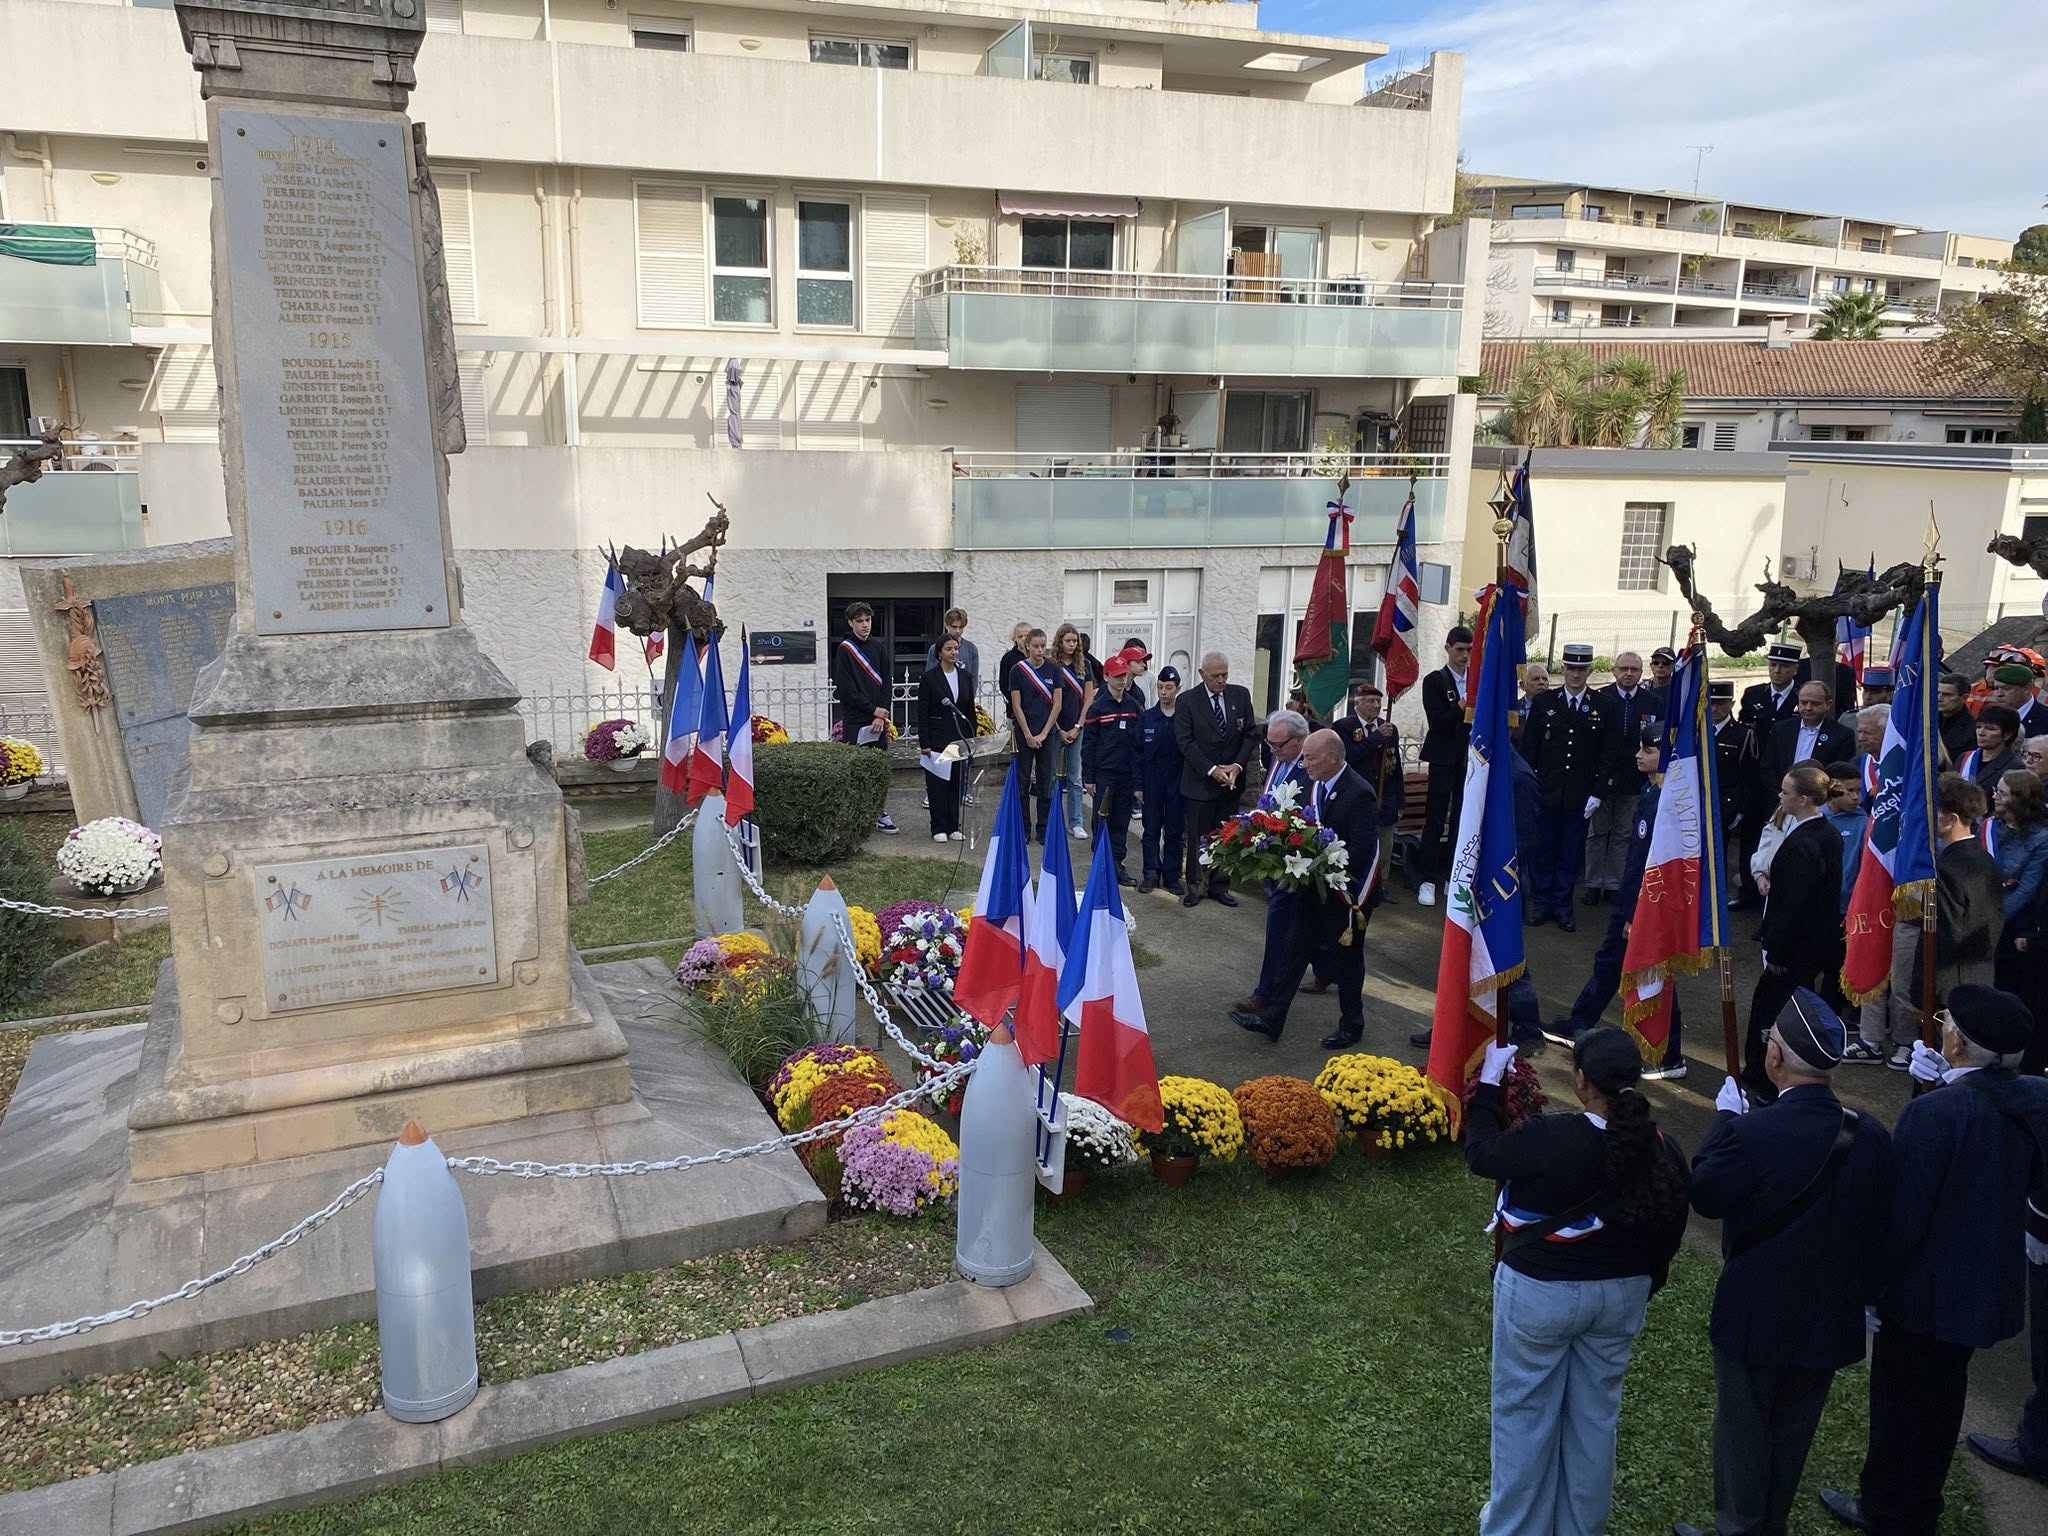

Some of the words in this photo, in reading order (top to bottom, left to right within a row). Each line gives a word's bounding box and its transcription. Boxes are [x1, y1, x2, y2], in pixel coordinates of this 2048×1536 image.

[292, 136, 336, 153] 1914
[325, 178, 354, 189] Albert
[267, 187, 316, 199] FERRIER
[319, 190, 353, 201] Octave
[263, 199, 316, 211] DAUMAS
[263, 225, 330, 238] ROUSSELET
[267, 263, 333, 275] MOURGUES
[336, 266, 364, 276] Pierre
[274, 288, 330, 300] TEIXIDOR
[333, 291, 363, 301] Ernest
[280, 301, 335, 312] CHARRAS
[339, 303, 359, 312] Jean
[278, 313, 323, 324] ALBERT
[325, 315, 364, 325] Fernand
[308, 332, 352, 349] 1915
[281, 358, 336, 368] BOURDEL
[338, 359, 364, 368] Louis
[333, 371, 362, 382] Joseph
[283, 383, 338, 392] GINESTET
[280, 395, 339, 404] GARRIGUE
[341, 395, 372, 405] Joseph
[331, 406, 375, 417] Raymond
[289, 418, 339, 428] REBELLE
[287, 430, 338, 439] DELTOUR
[341, 430, 372, 440] Joseph
[340, 441, 368, 450] Pierre
[295, 453, 337, 462] THIBAL
[340, 453, 368, 462] André
[293, 465, 341, 474] BERNIER
[345, 464, 372, 473] André
[292, 476, 352, 486] AZAUBERT
[355, 476, 374, 485] Paul
[298, 488, 343, 497] BALSAN
[345, 487, 371, 496] Henri
[303, 499, 346, 509] PAULHE
[349, 499, 368, 508] Jean
[324, 519, 368, 535] 1916
[290, 545, 352, 556] BRINGUIER
[353, 544, 388, 555] Jacques
[308, 556, 344, 566] FLORY
[346, 556, 372, 565] Henri
[344, 567, 379, 576] Charles
[352, 578, 388, 587] Camille
[145, 594, 175, 606] MORTS
[180, 590, 204, 602] POUR
[209, 588, 220, 598] LA
[300, 590, 351, 601] LAFFONT
[309, 601, 350, 611] ALBERT
[352, 600, 380, 609] André
[317, 871, 327, 880] A
[330, 868, 347, 880] LA
[350, 862, 413, 878] MEMOIRE
[416, 860, 433, 871] DE
